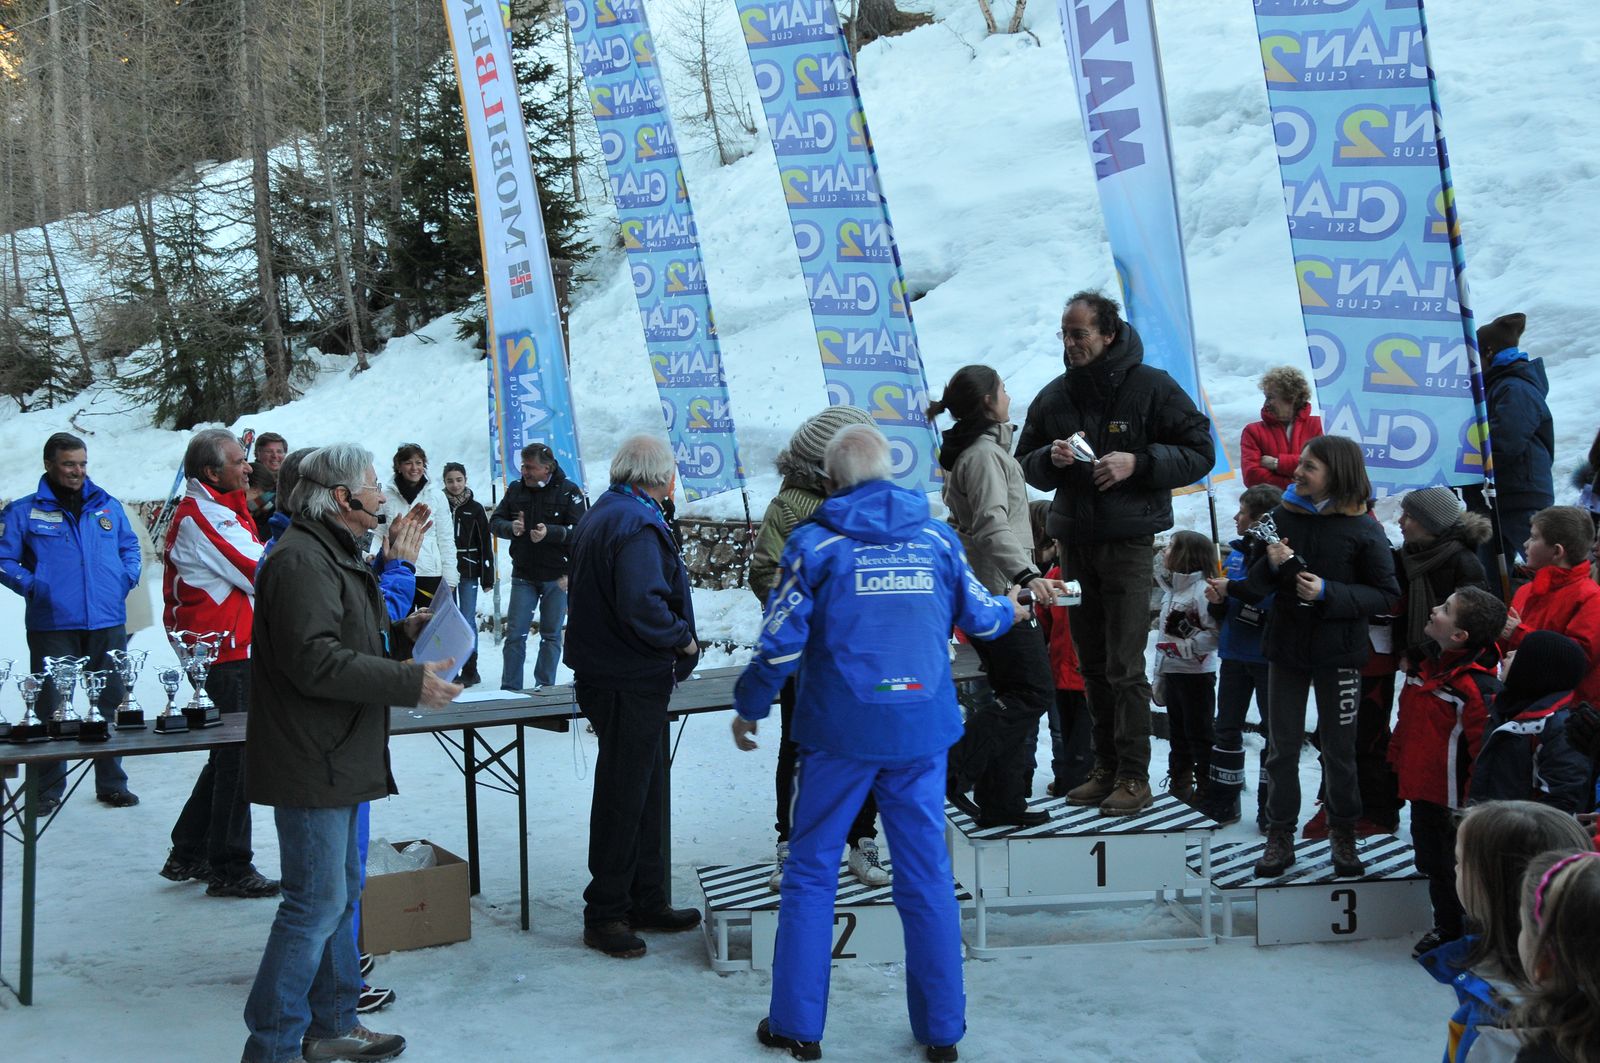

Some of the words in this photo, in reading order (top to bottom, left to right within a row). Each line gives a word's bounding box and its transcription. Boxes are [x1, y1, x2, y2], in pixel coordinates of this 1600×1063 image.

[1089, 840, 1107, 887] 1
[1330, 888, 1358, 935] 3
[832, 912, 857, 960] 2
